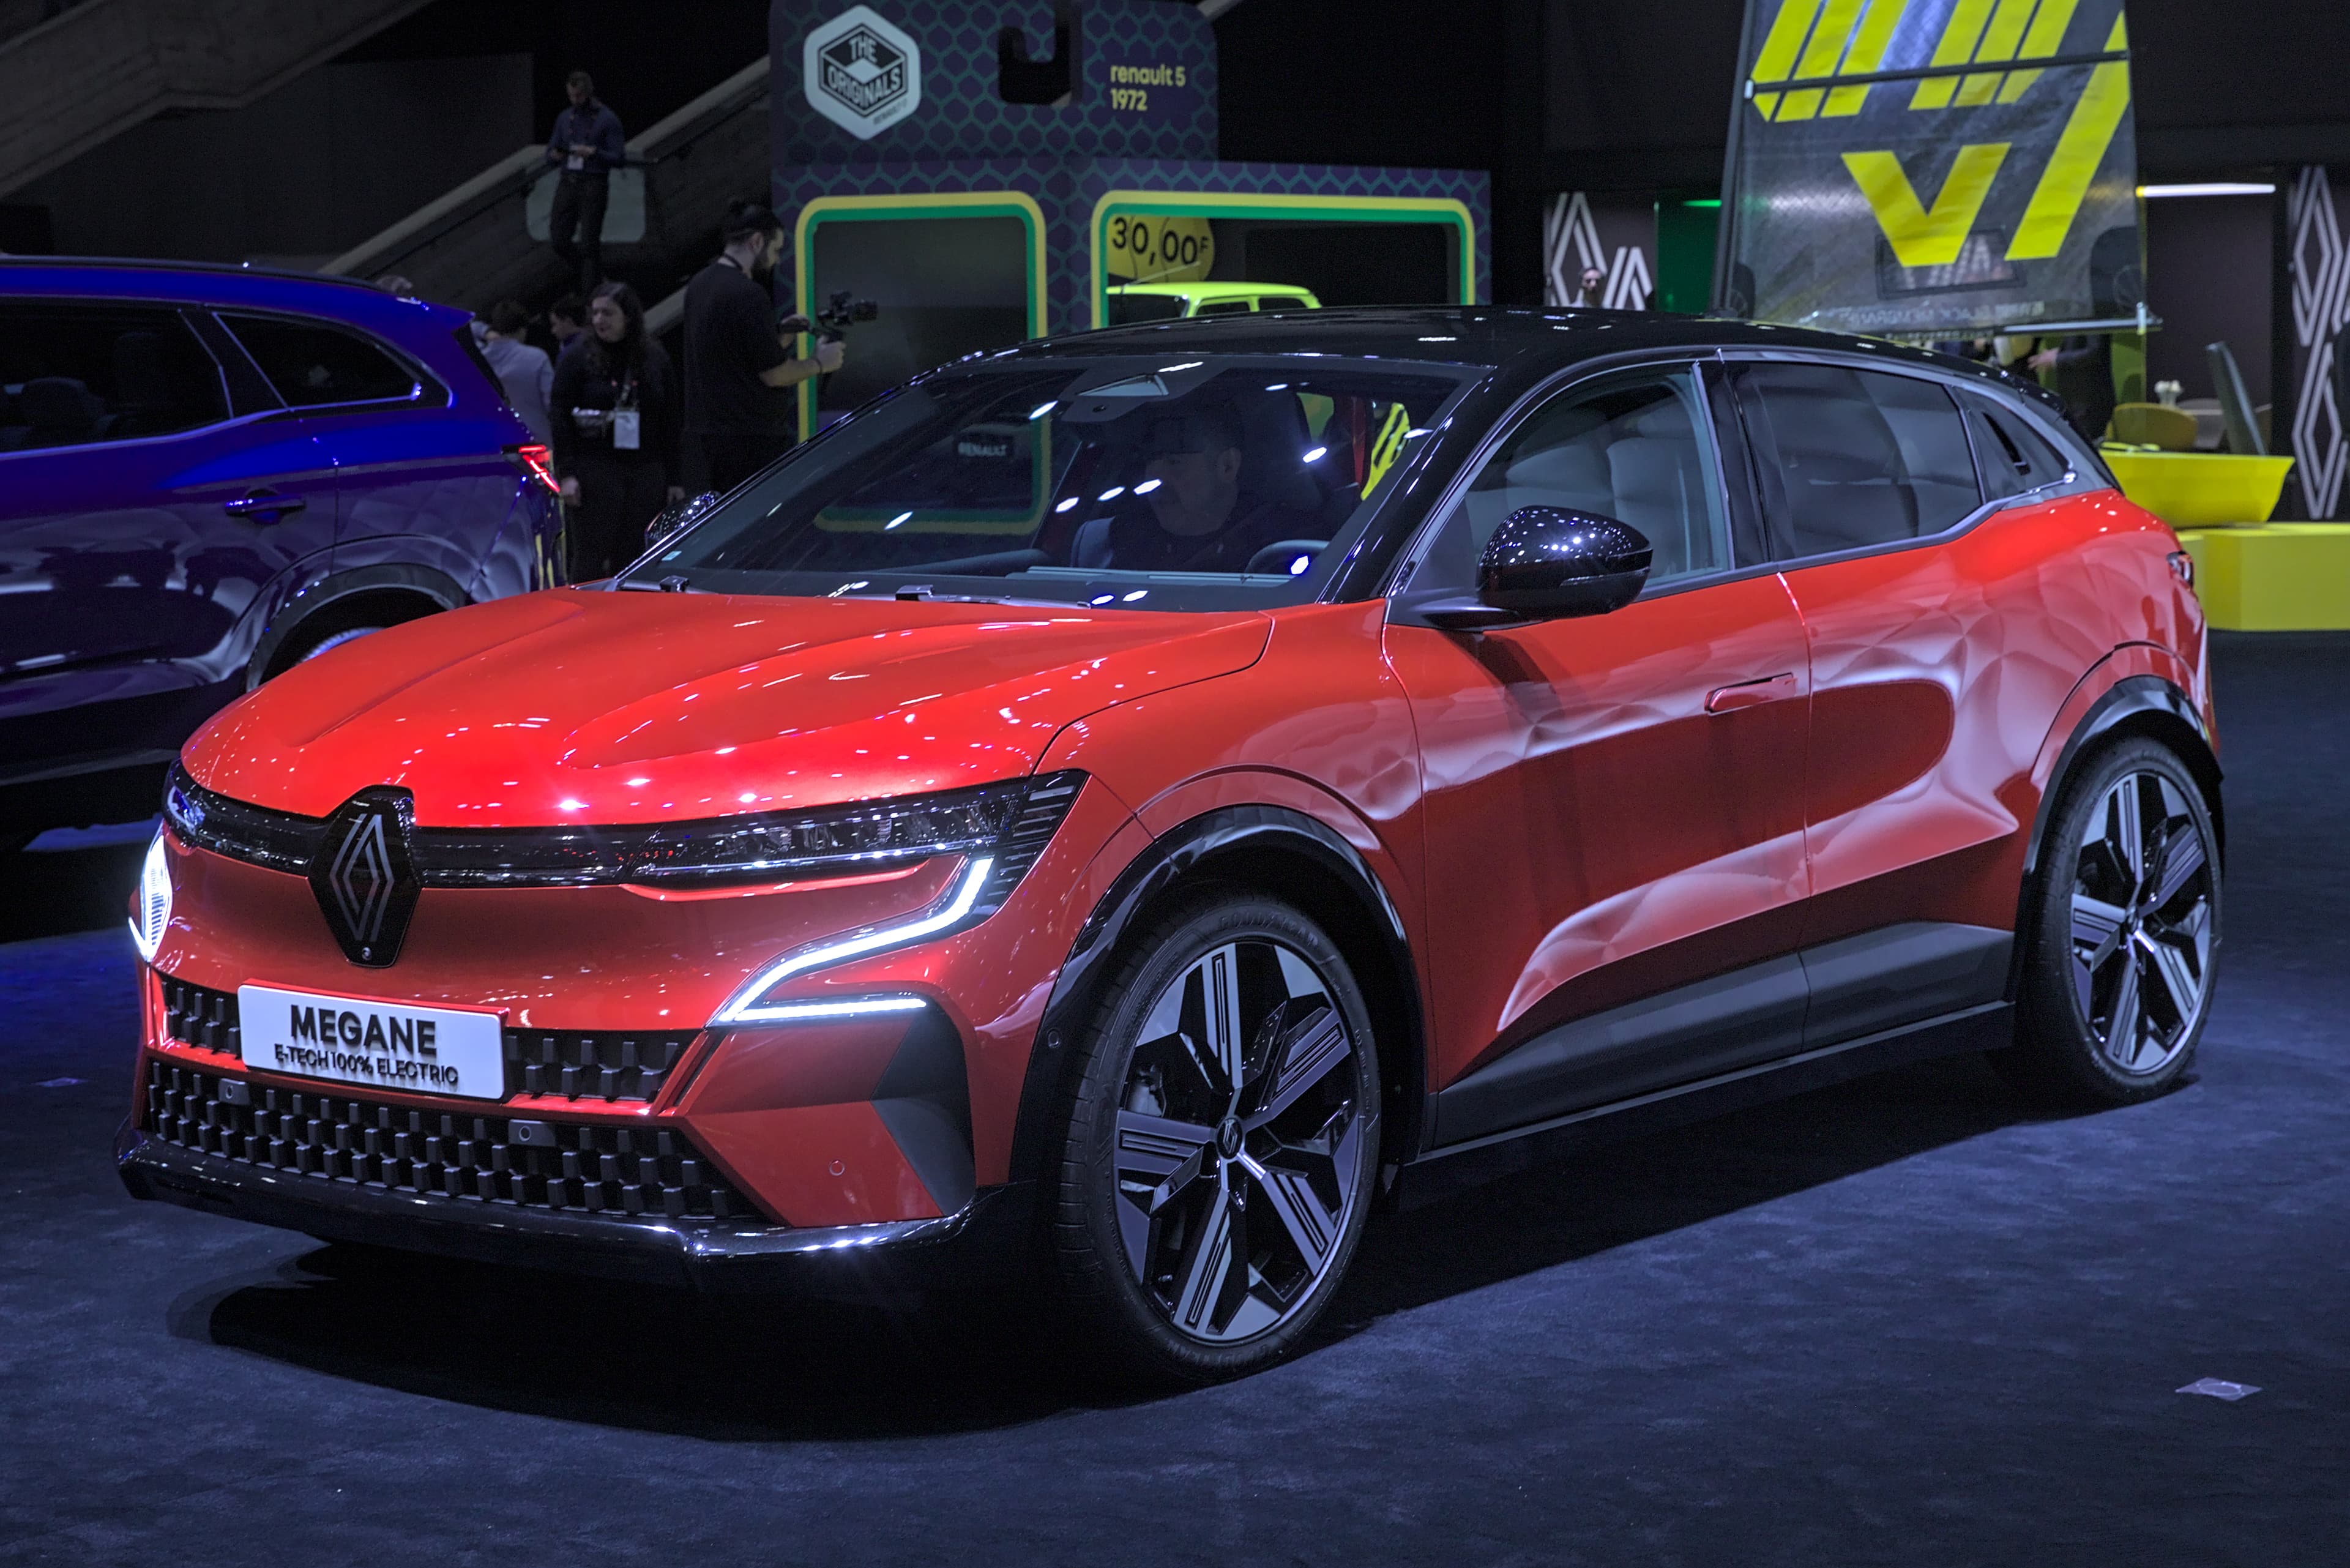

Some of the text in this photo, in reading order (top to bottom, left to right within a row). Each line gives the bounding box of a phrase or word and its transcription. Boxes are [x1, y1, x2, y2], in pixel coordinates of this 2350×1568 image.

[849, 34, 877, 62] THE
[828, 67, 901, 106] ORIGINALS
[1110, 64, 1185, 88] renault 5
[1110, 88, 1147, 111] 1972
[291, 1004, 436, 1057] MEGANE
[275, 1043, 459, 1083] E-TECH 100% ELECTRIC
